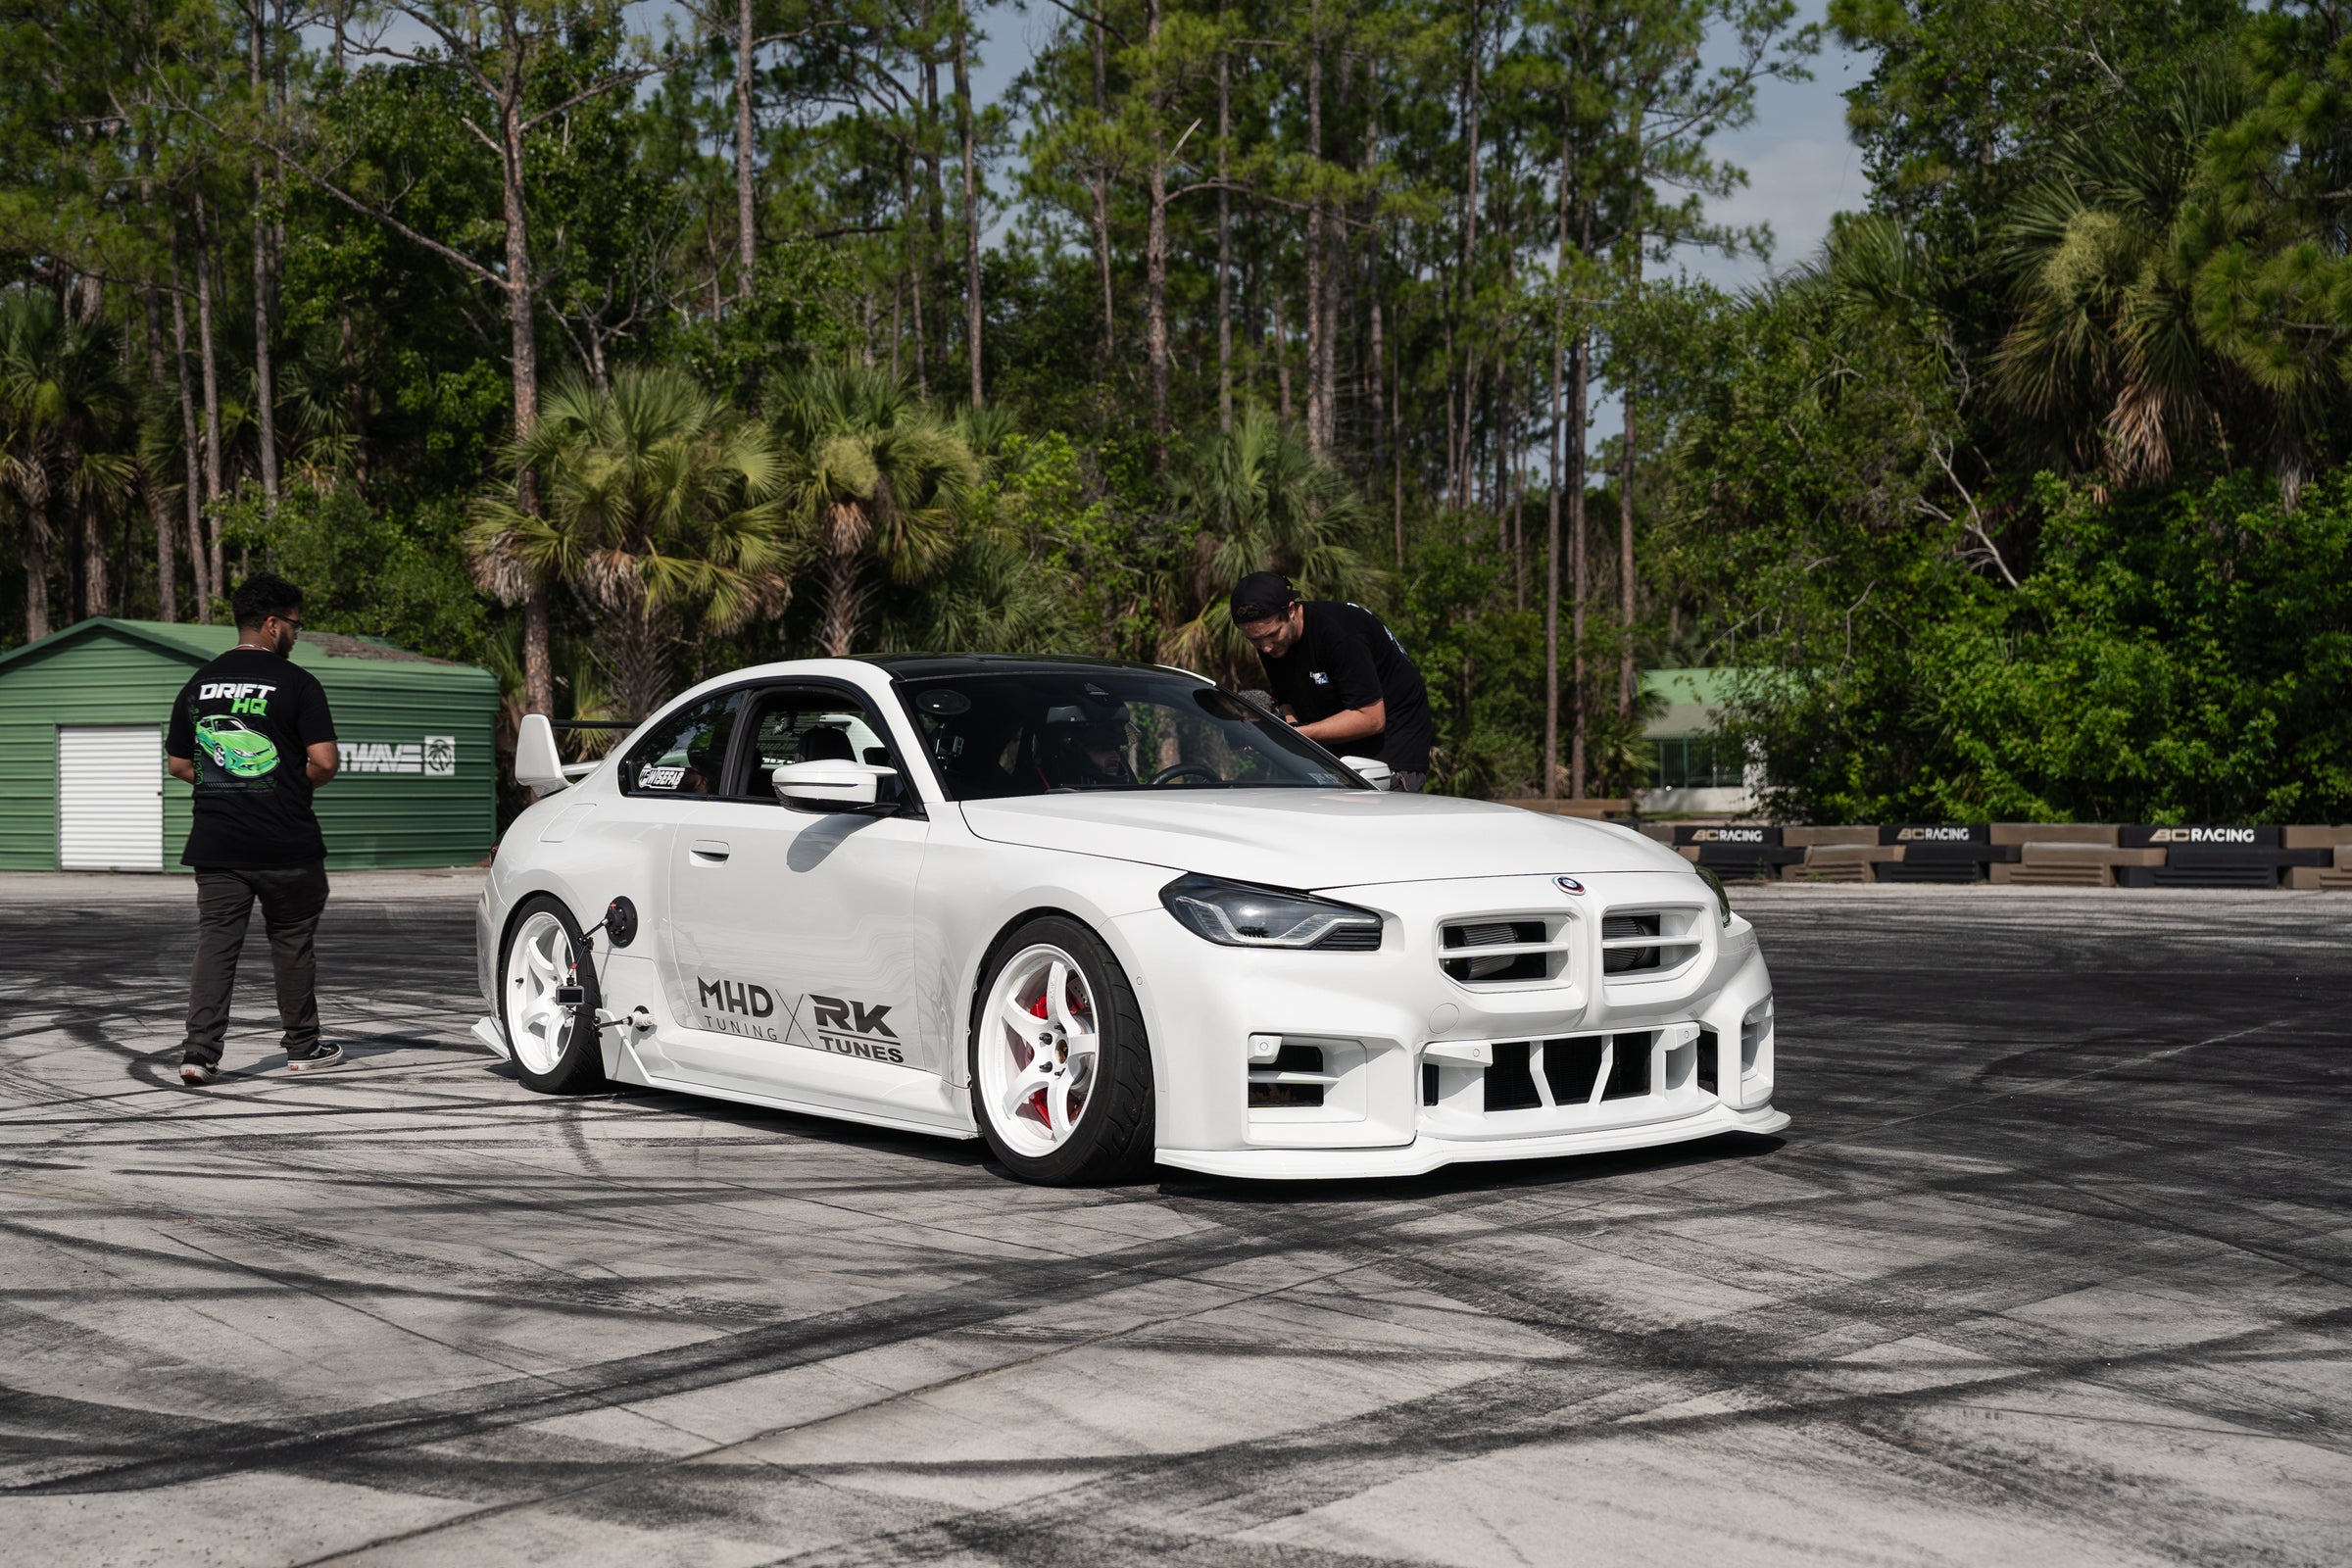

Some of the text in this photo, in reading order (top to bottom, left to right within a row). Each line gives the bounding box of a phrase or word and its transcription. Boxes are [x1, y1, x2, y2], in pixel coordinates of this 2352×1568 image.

[199, 683, 276, 700] DRIFT
[230, 697, 268, 716] HQ
[336, 743, 421, 772] TWAVE
[1719, 829, 1763, 842] RACING
[1925, 827, 1970, 841] RACING
[2191, 828, 2255, 843] RACING
[697, 976, 773, 1018] MHD
[808, 994, 899, 1038] RK
[704, 1015, 777, 1041] TUNING
[819, 1036, 904, 1063] TUNES
